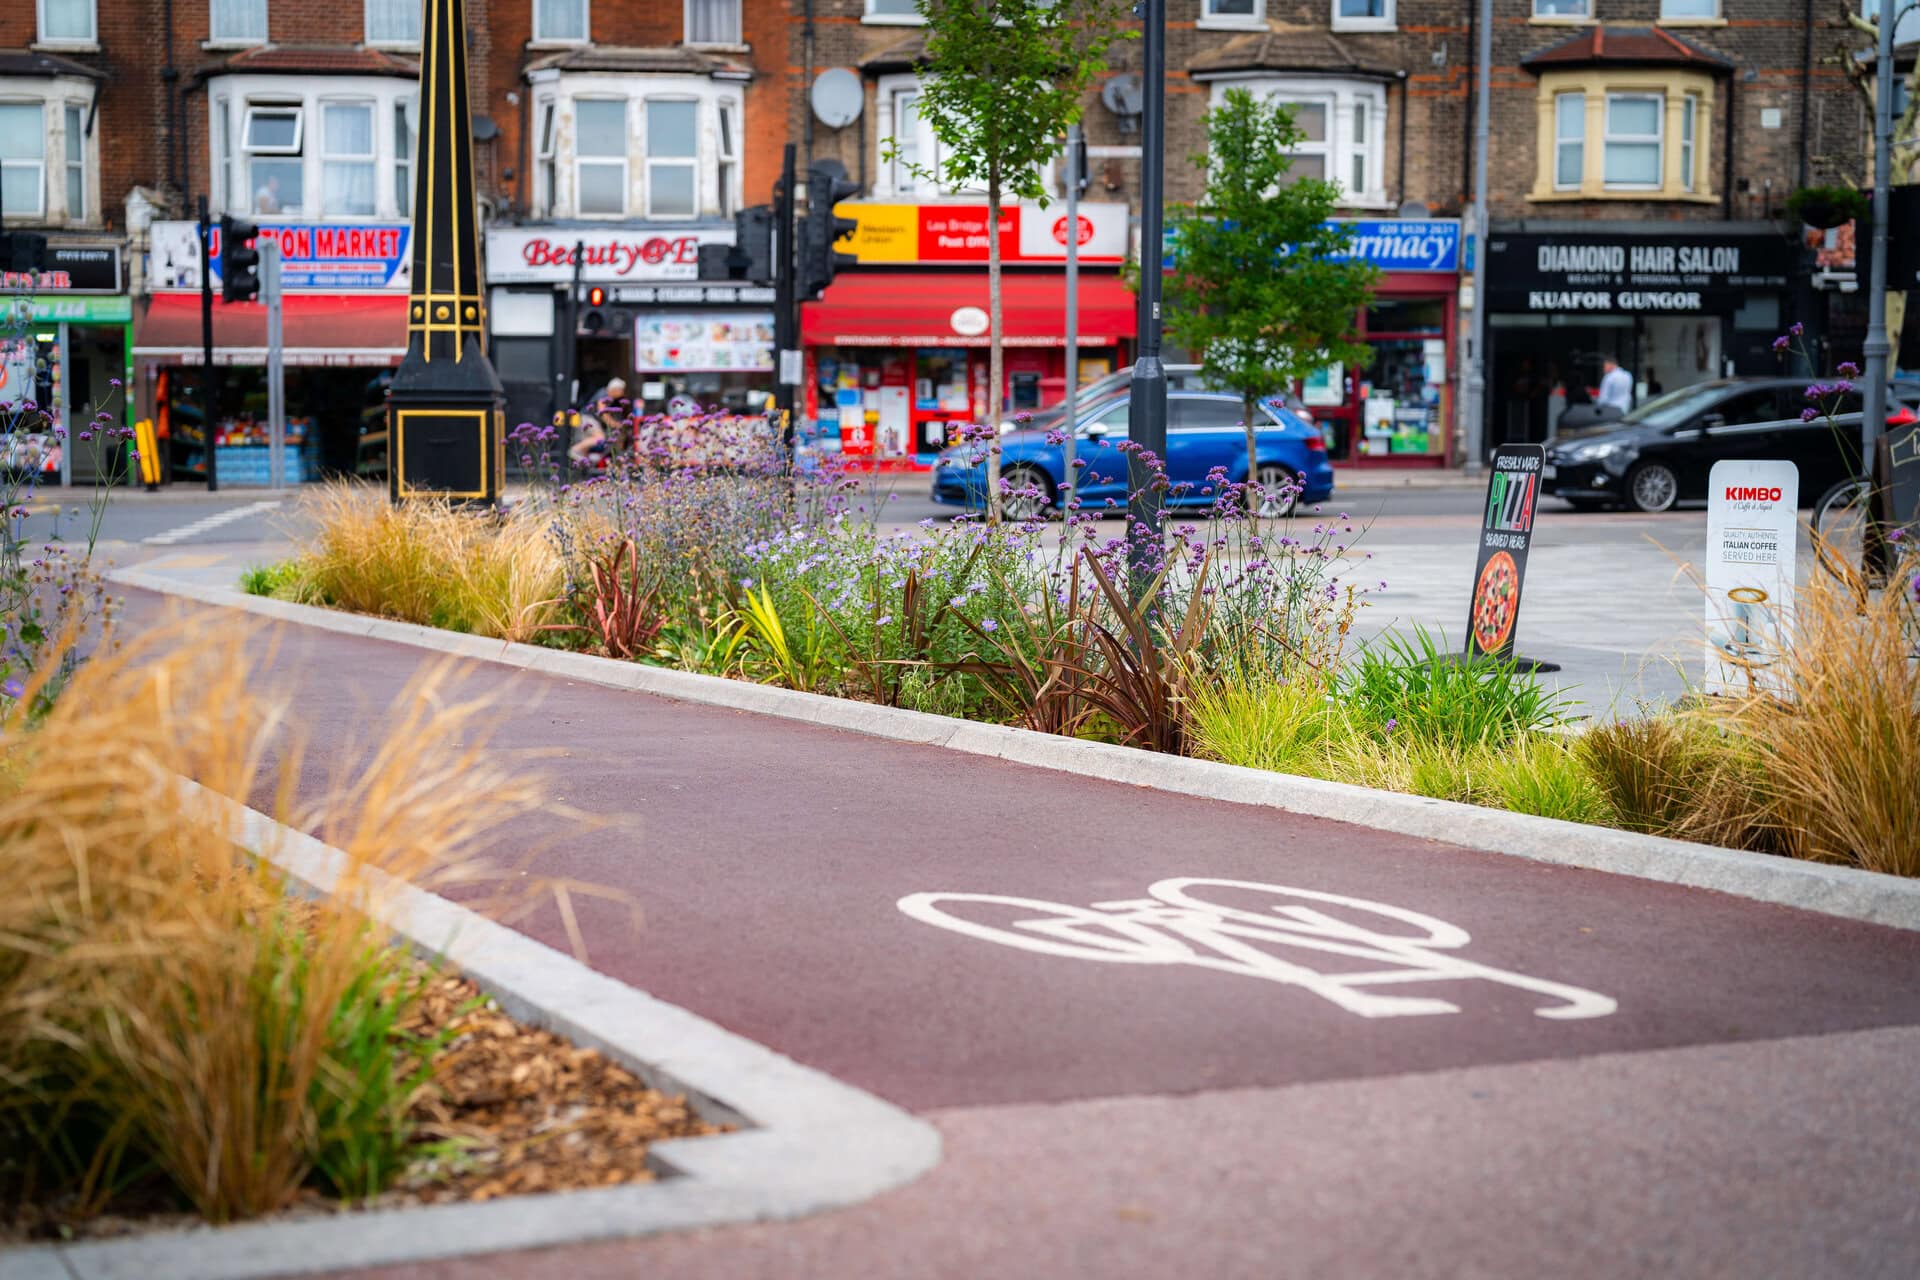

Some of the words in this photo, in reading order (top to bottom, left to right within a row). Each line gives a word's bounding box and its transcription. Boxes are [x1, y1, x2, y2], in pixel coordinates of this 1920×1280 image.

[985, 219, 1013, 232] ad
[316, 228, 400, 259] MARKET
[938, 235, 965, 248] Post
[1330, 234, 1454, 268] armacy
[1538, 245, 1625, 272] DIAMOND
[1630, 245, 1675, 272] HAIR
[1678, 246, 1739, 273] SALON
[1529, 291, 1611, 309] KUAFOR
[1617, 291, 1701, 309] GUNGOR
[1521, 456, 1540, 471] MADE
[1486, 471, 1536, 532] PIZZA
[1725, 487, 1781, 502] KIMBO
[1485, 533, 1509, 548] SERVED
[1508, 534, 1526, 549] HERE
[1723, 541, 1749, 549] ITALIAN
[1750, 542, 1777, 550] COFFEE
[1723, 551, 1753, 561] SERVED
[1755, 553, 1777, 561] HERE
